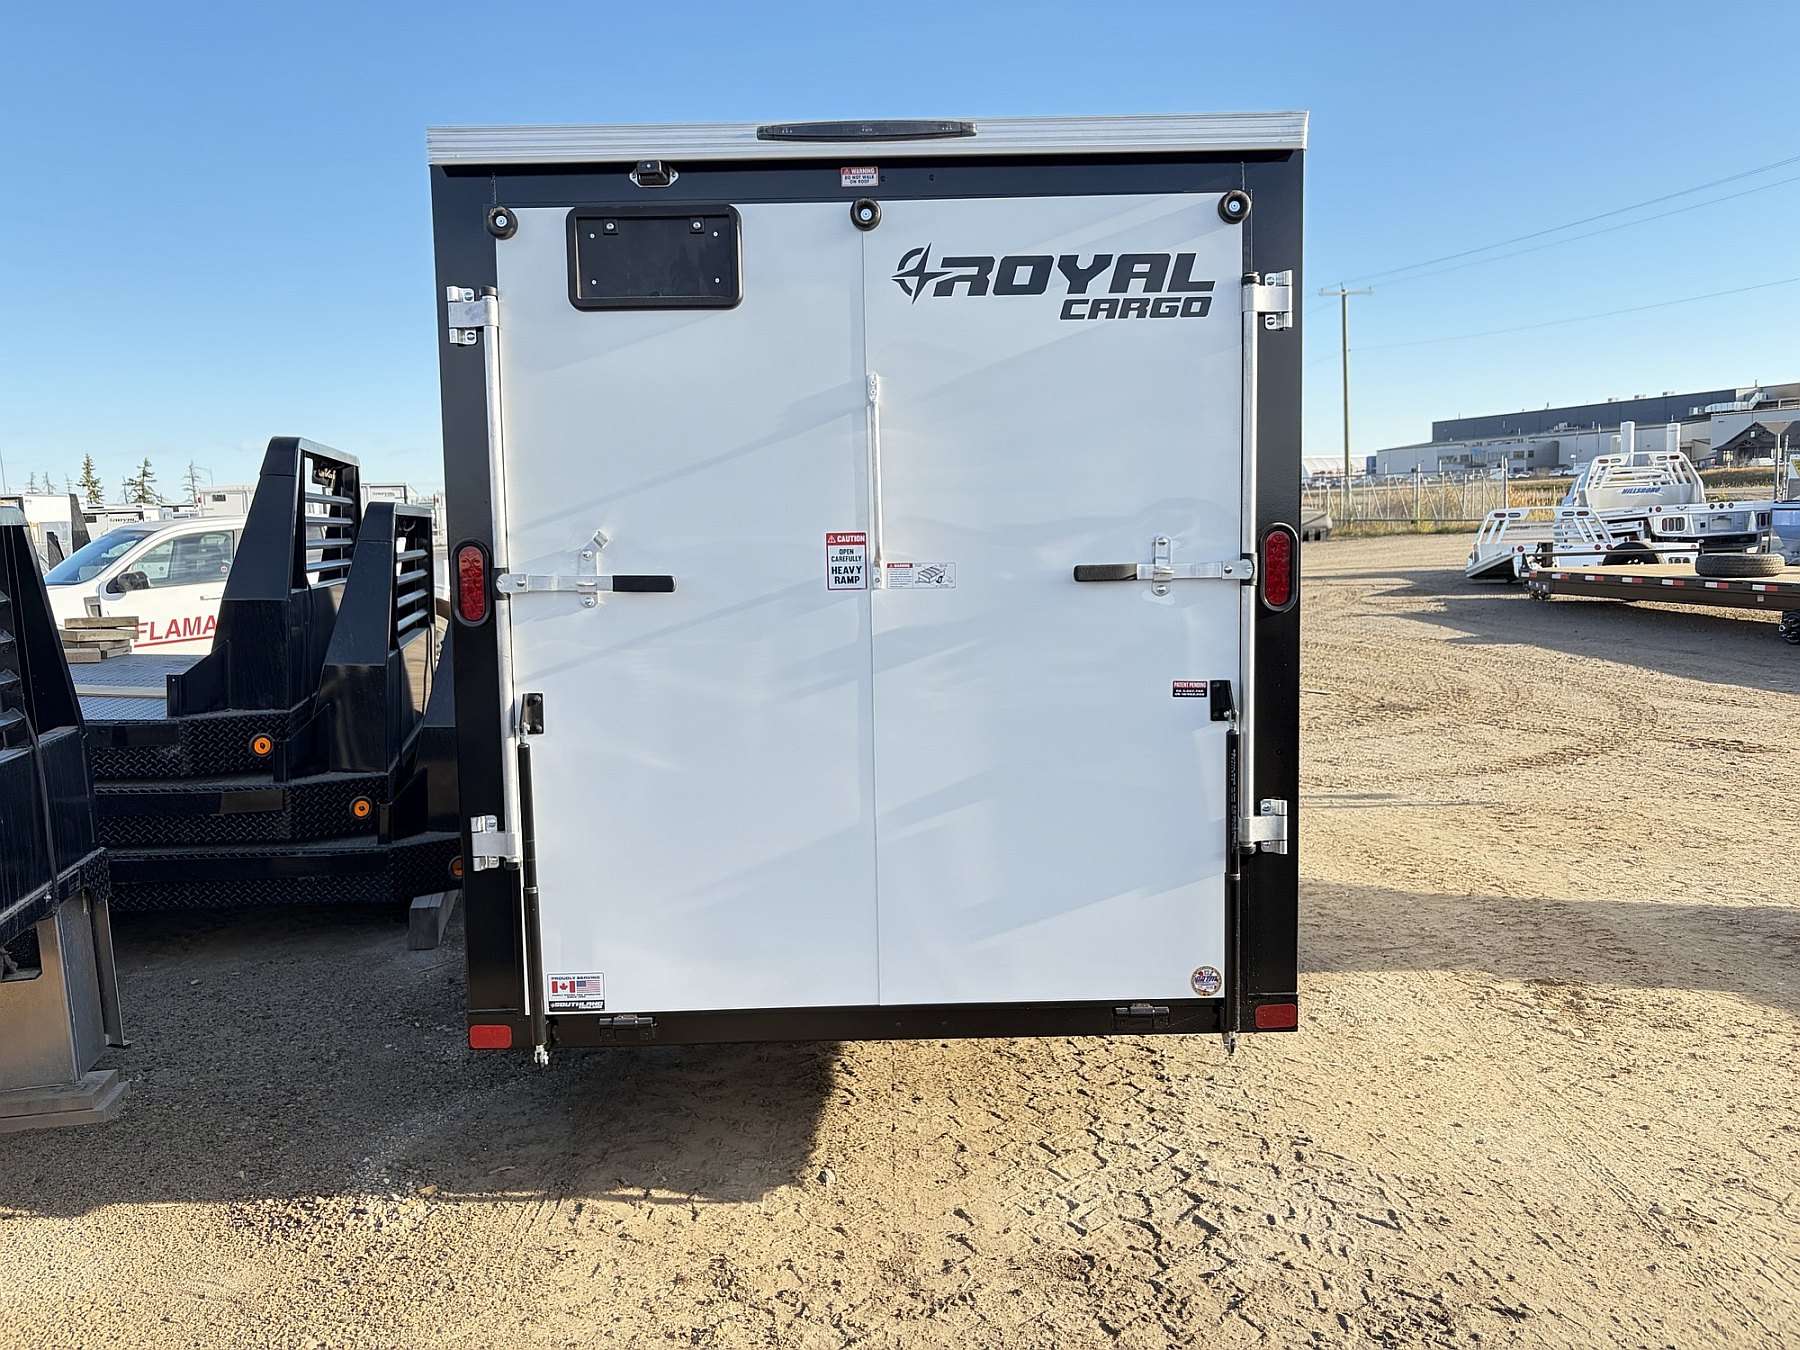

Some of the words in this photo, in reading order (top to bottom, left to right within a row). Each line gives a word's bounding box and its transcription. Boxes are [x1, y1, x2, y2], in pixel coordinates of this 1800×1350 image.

[932, 253, 1216, 297] ROYAL
[1060, 297, 1213, 320] CARGO
[836, 535, 865, 543] CAUTION
[831, 565, 863, 575] HEAVY
[834, 576, 861, 585] RAMP
